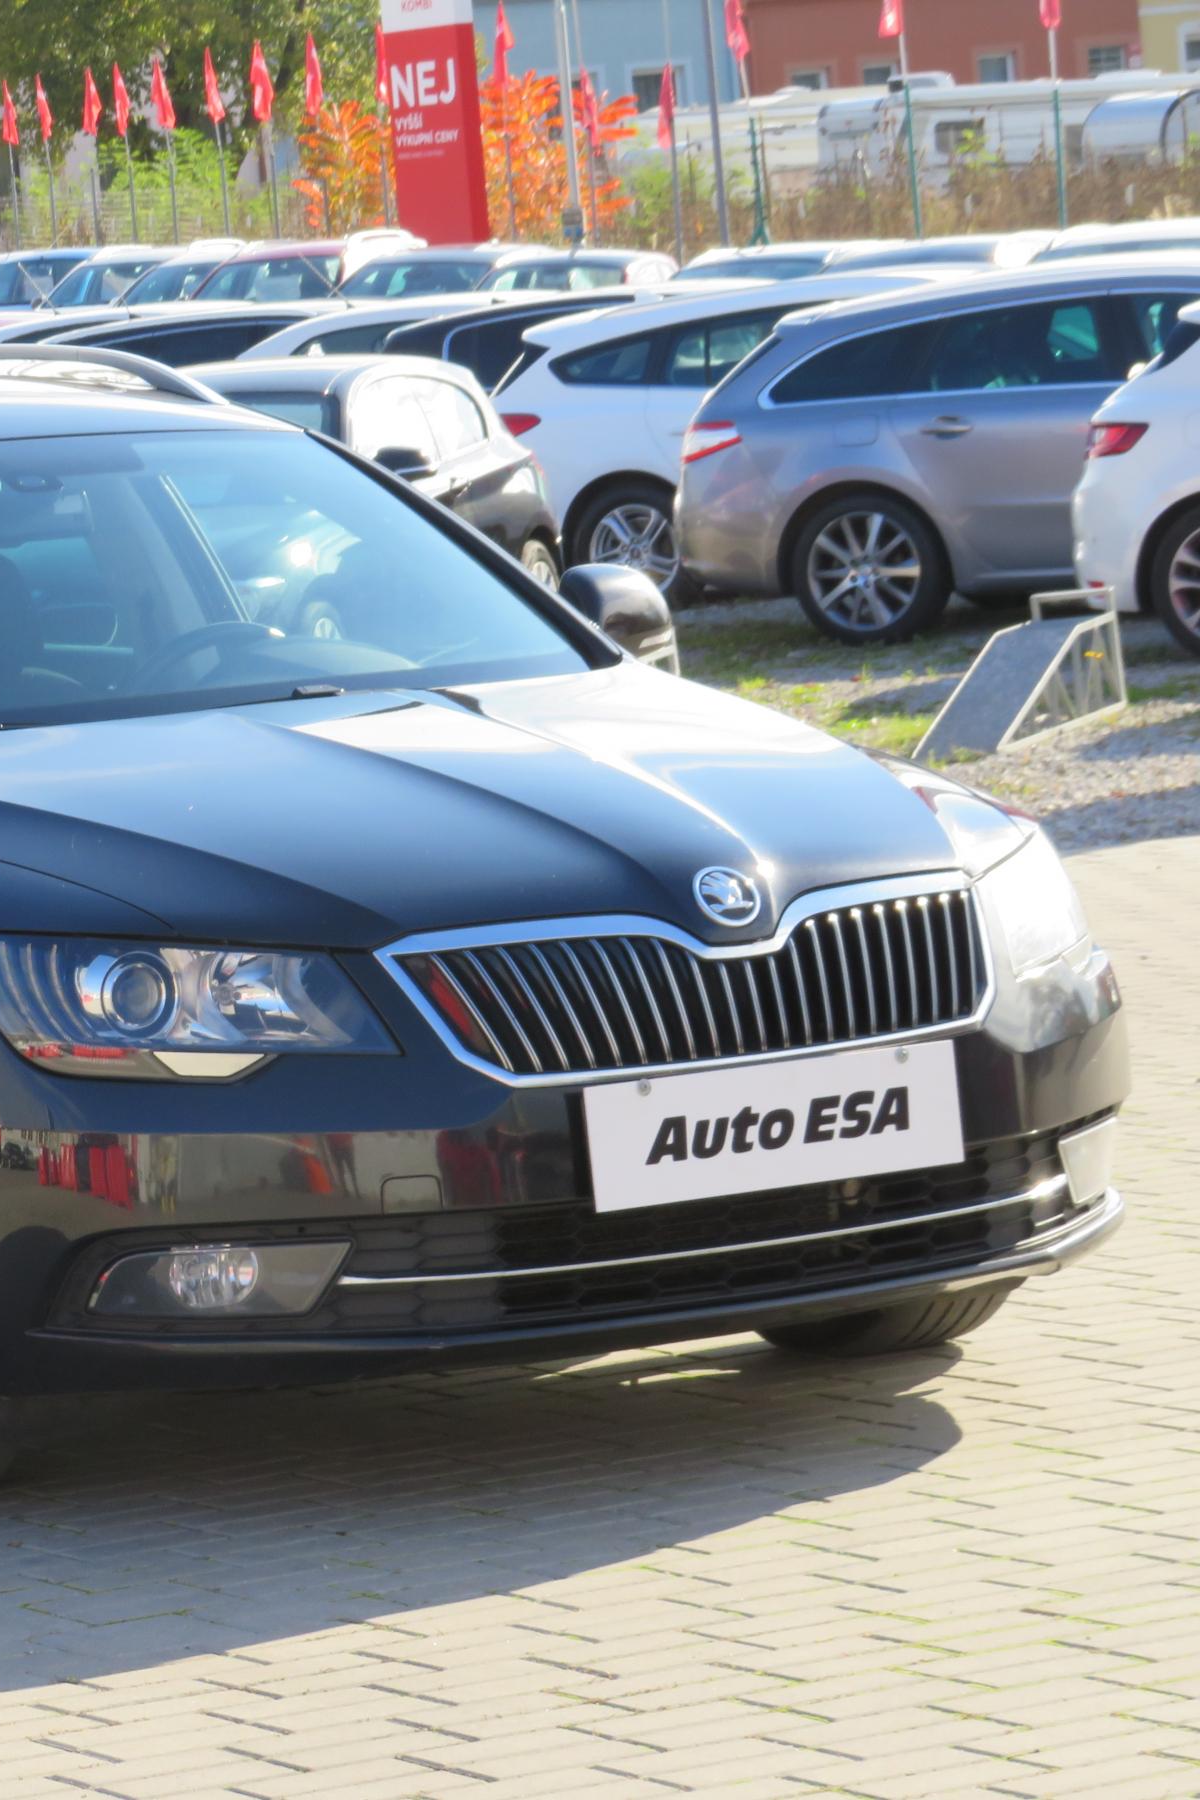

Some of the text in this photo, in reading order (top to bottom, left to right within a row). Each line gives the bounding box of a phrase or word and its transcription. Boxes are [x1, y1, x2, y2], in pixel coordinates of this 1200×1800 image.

[390, 58, 456, 110] NEJ
[434, 129, 459, 144] CENY
[645, 1085, 910, 1165] Auto ESA
